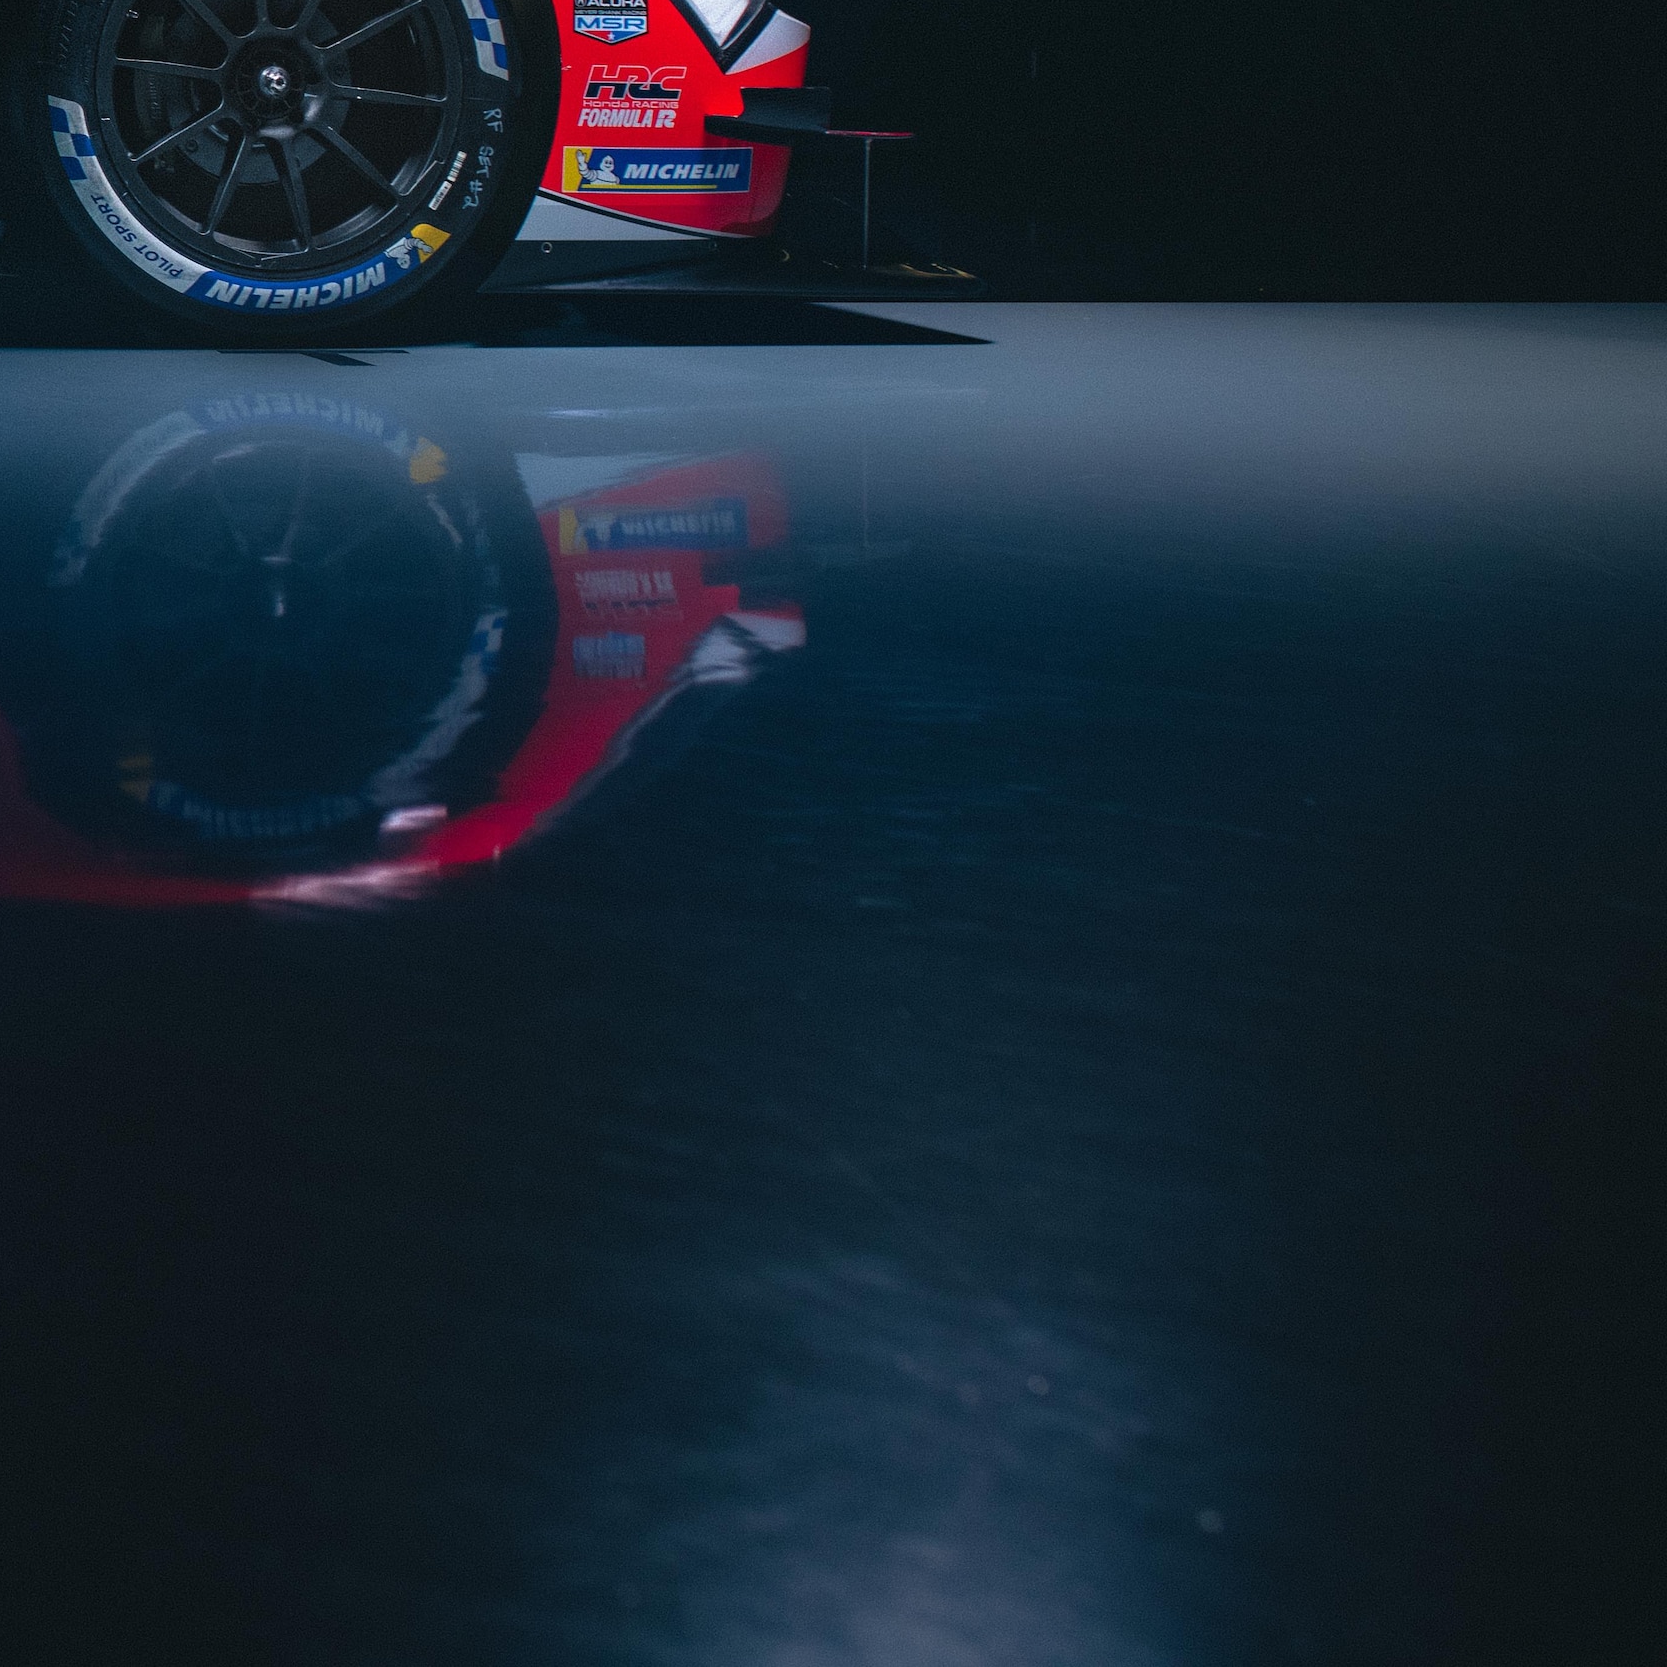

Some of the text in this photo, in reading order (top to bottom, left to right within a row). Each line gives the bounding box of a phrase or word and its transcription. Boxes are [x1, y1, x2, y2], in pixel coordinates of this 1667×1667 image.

[576, 17, 646, 30] MSR
[583, 64, 687, 99] HRC
[583, 99, 679, 109] Honda RACING
[482, 108, 504, 133] RF
[577, 108, 656, 128] FORMULA
[623, 163, 740, 179] MICHELIN
[90, 195, 386, 308] MICHELIN PILOT SPORT
